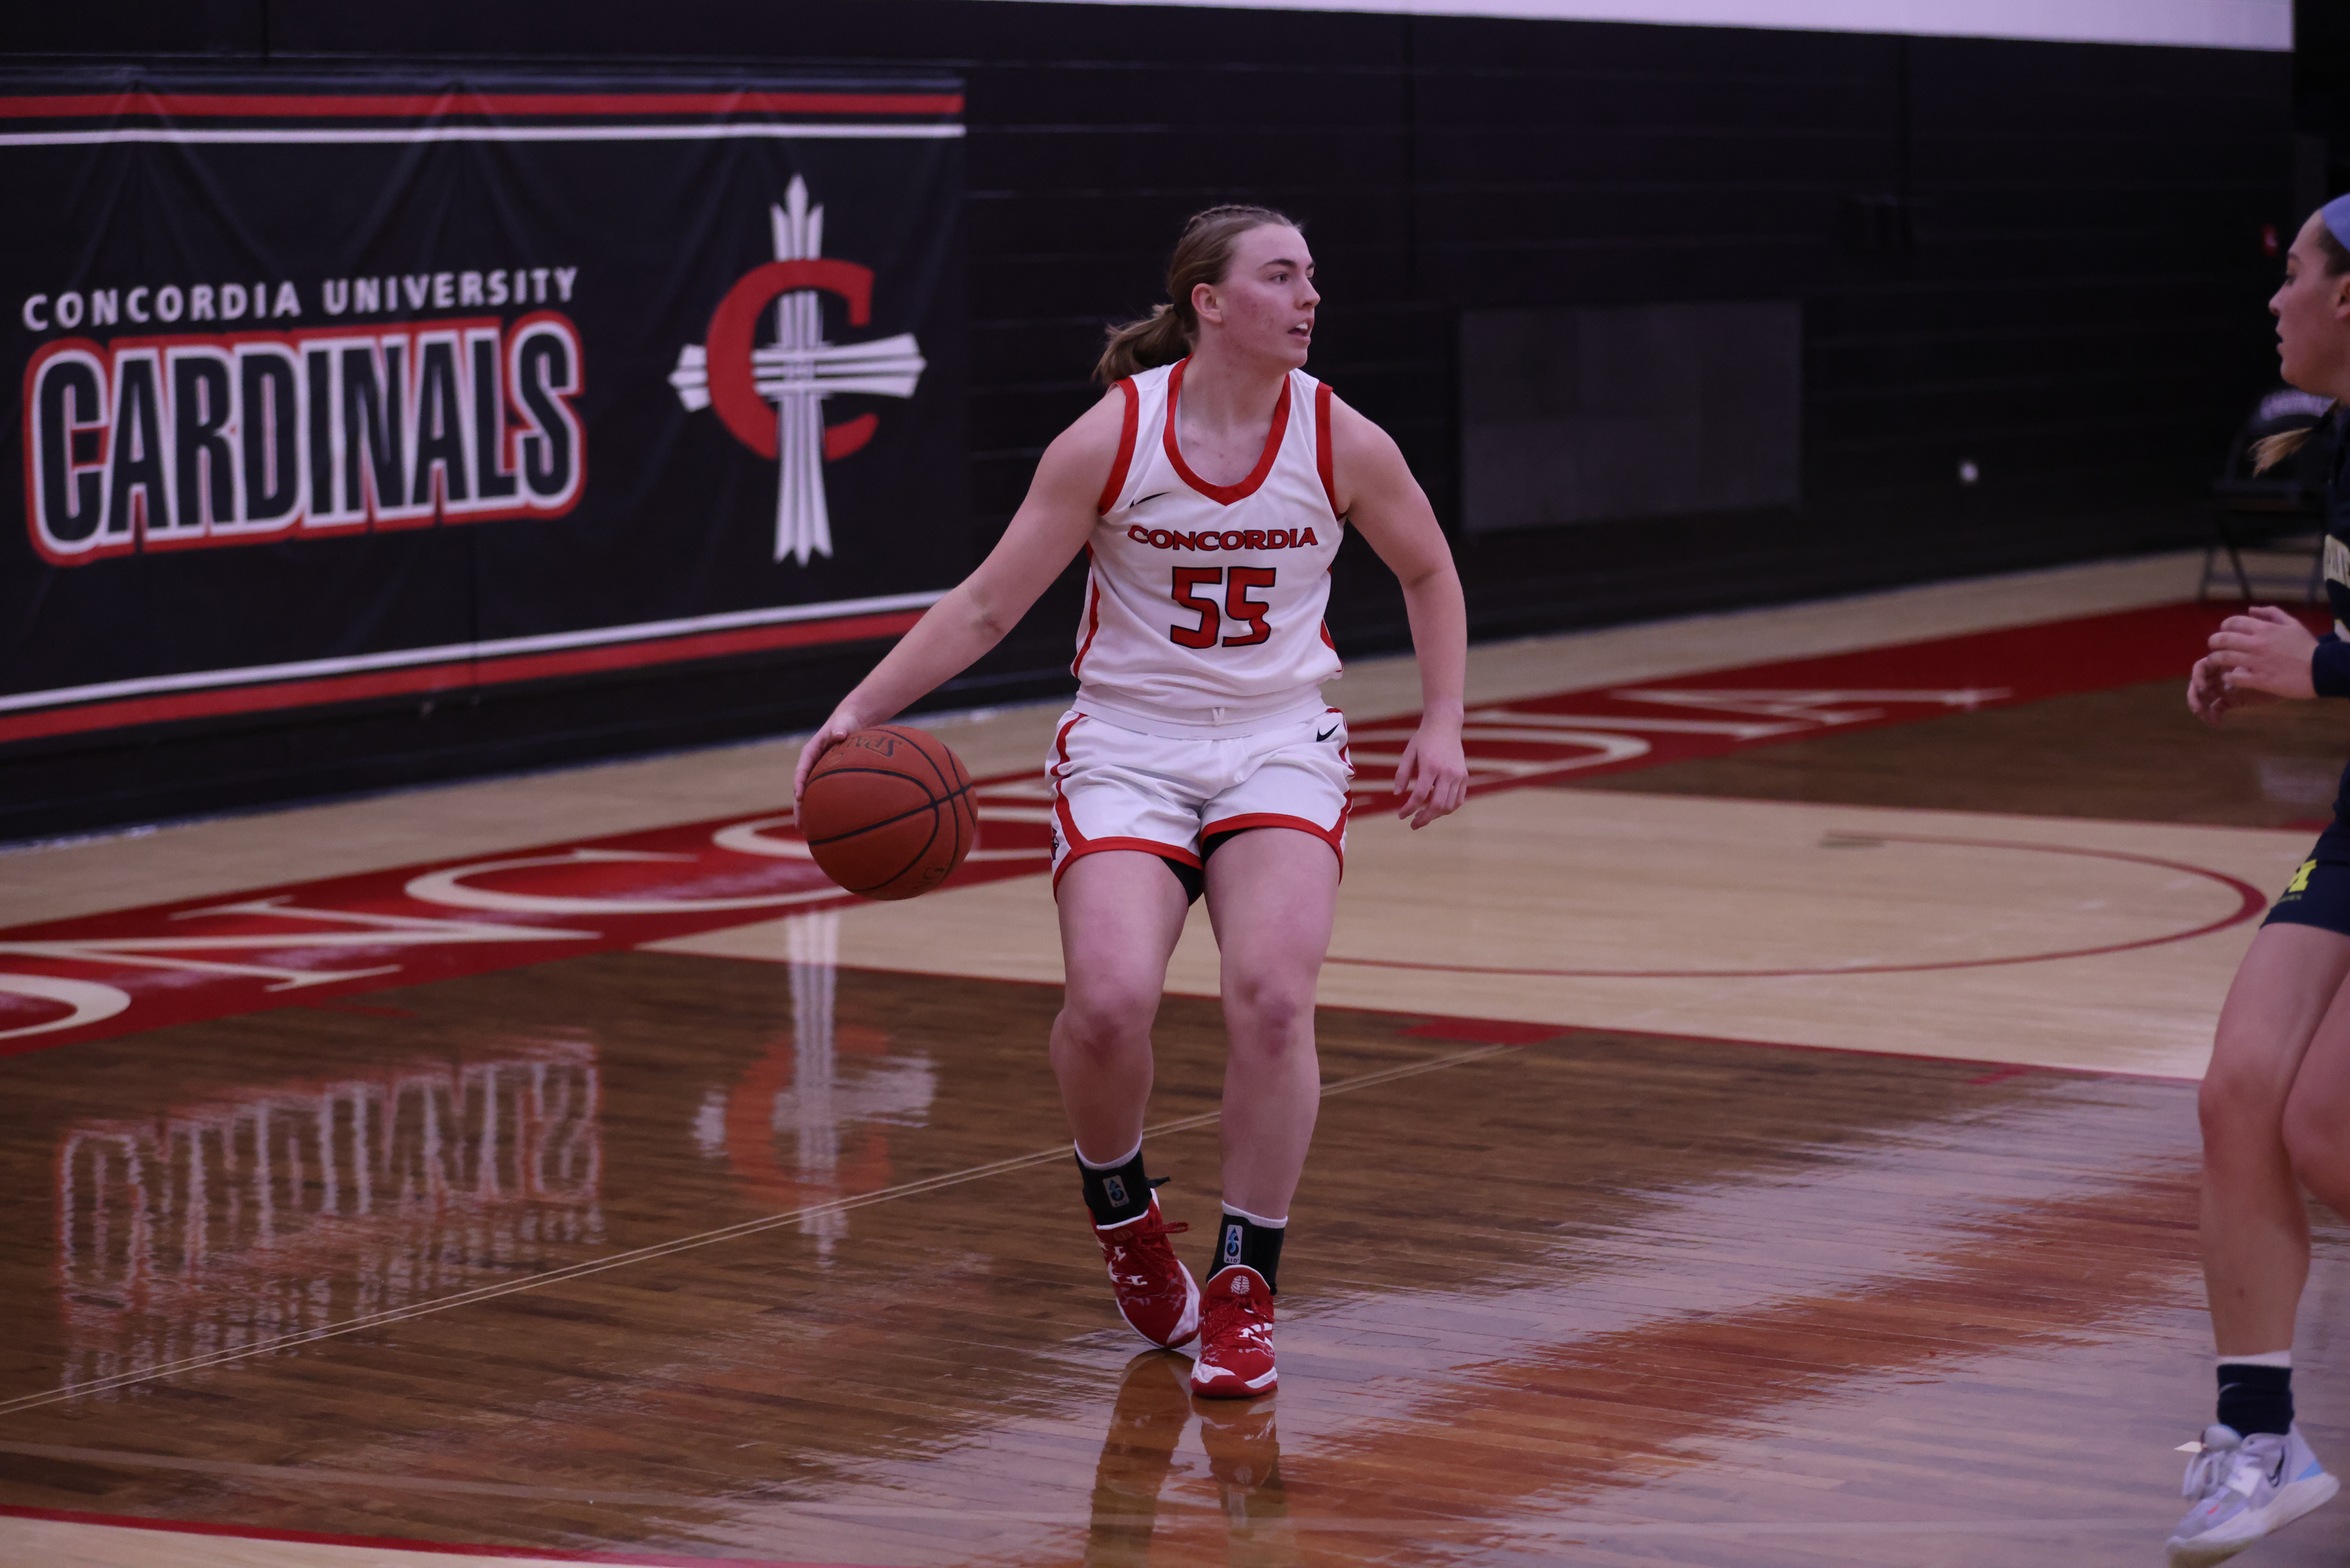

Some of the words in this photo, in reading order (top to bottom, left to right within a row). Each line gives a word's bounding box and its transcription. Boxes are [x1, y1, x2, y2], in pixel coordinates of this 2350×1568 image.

[22, 281, 302, 331] CONCORDIA
[322, 267, 579, 315] UNIVERSITY
[24, 311, 585, 565] CARDINALS
[1127, 525, 1318, 551] CONCORDIA
[1170, 566, 1277, 649] 55
